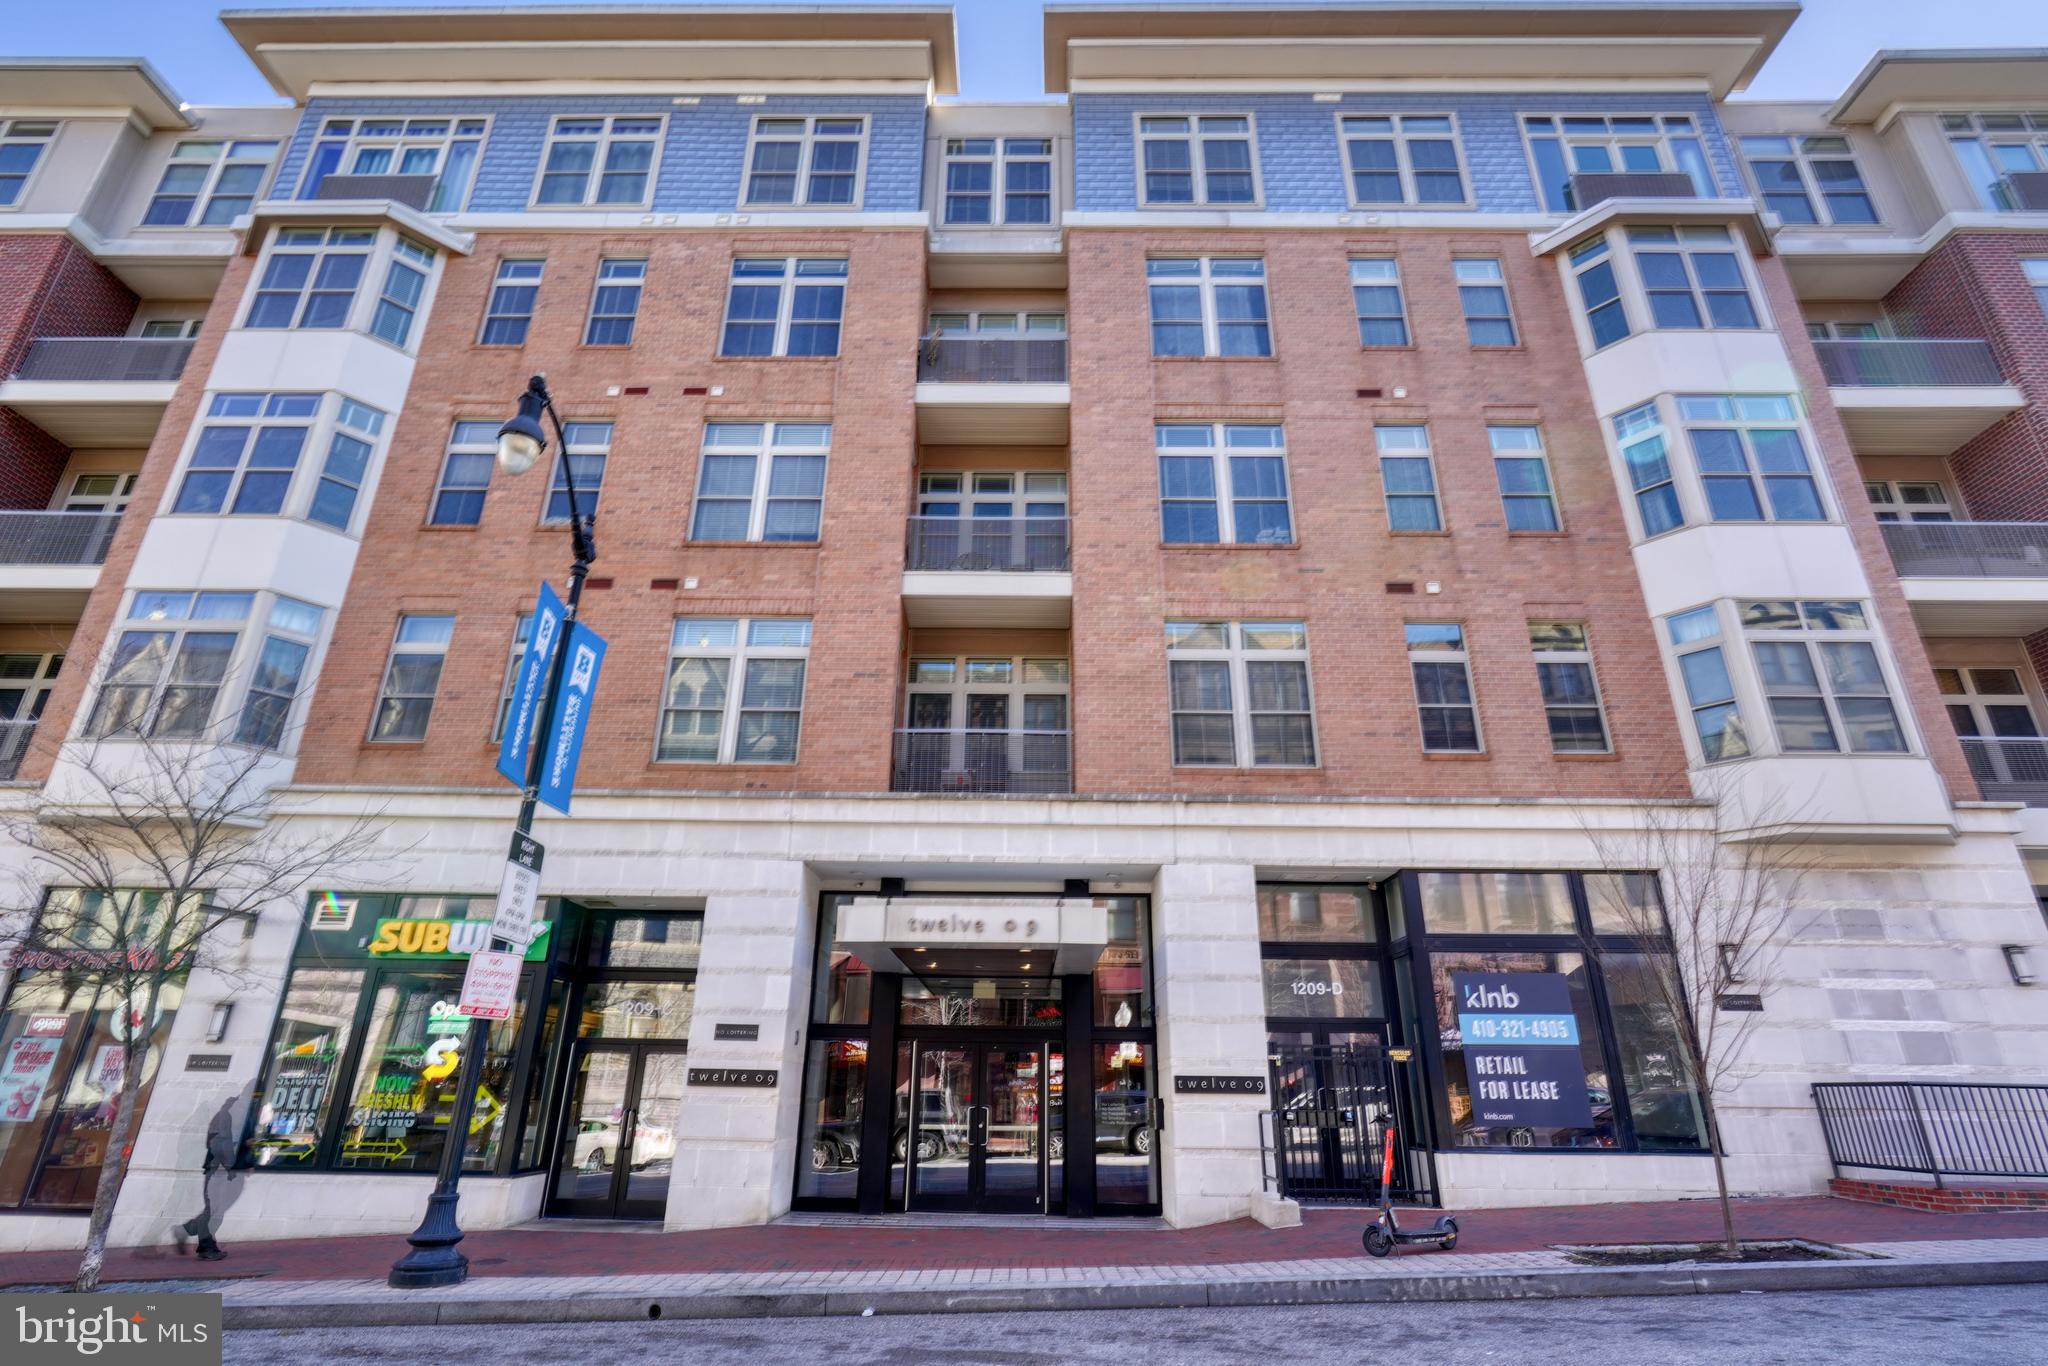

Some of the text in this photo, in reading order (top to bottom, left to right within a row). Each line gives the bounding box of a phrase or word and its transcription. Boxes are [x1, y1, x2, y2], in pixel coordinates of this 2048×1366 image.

[908, 914, 984, 934] twelve
[368, 920, 547, 955] SUBWY
[127, 947, 185, 970] KIG
[1291, 982, 1343, 995] 1209-D
[1464, 984, 1520, 1008] klnb
[1472, 1019, 1569, 1039] 410-321-4905
[1475, 1055, 1528, 1075] RETAIL
[276, 1072, 328, 1085] SLICING
[375, 1075, 413, 1092] NOW
[690, 1070, 747, 1082] twelve
[1177, 1077, 1237, 1089] twelve
[271, 1087, 323, 1109] DELI
[1479, 1081, 1560, 1100] FOR LEASE
[352, 1110, 417, 1128] SLICING
[1484, 1112, 1514, 1121] klnb.com
